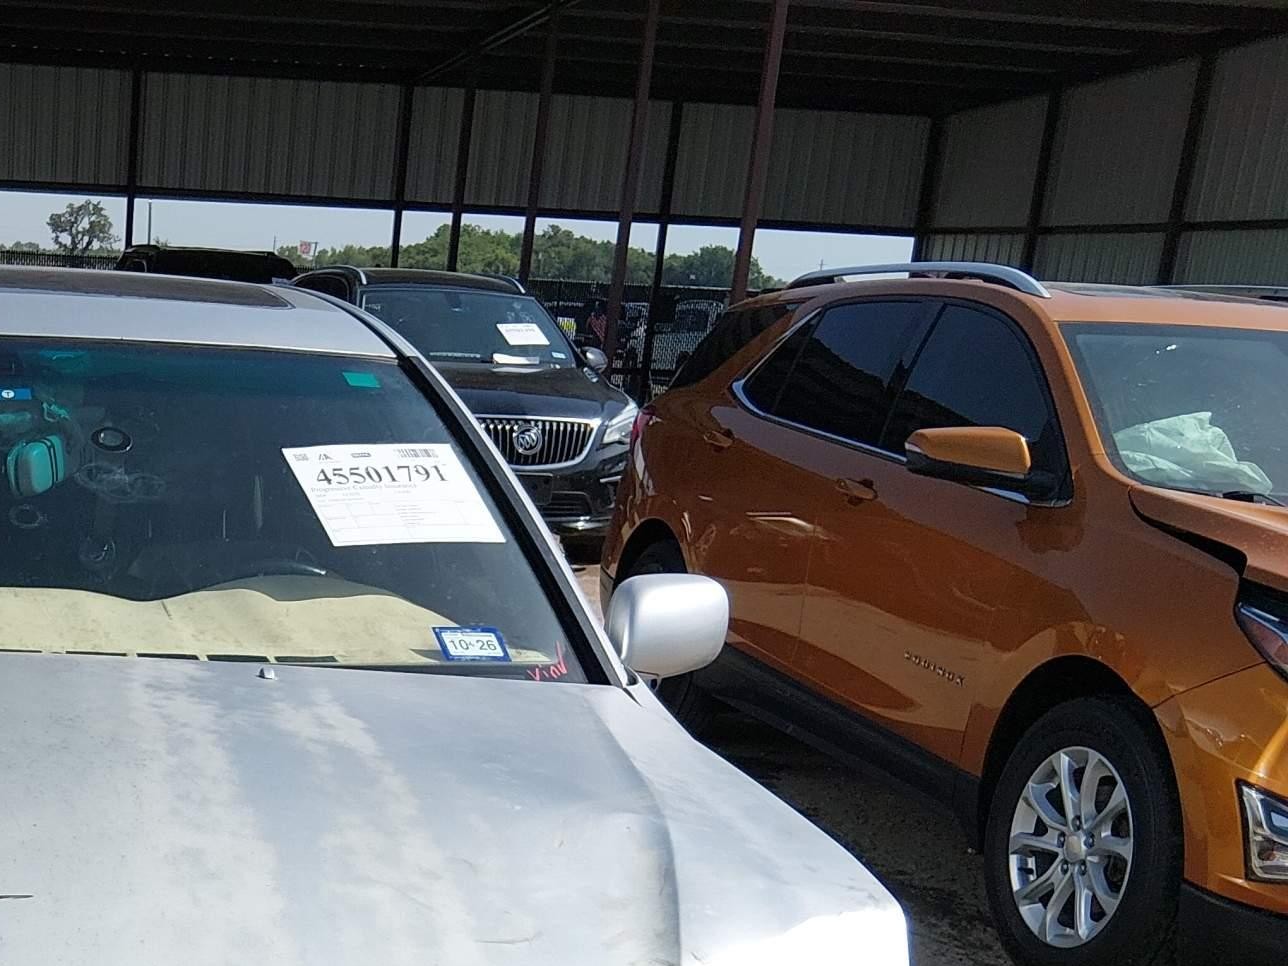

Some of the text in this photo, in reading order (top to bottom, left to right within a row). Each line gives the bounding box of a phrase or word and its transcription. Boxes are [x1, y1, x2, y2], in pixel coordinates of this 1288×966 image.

[317, 465, 448, 485] 45501791
[450, 639, 497, 651] 10 26
